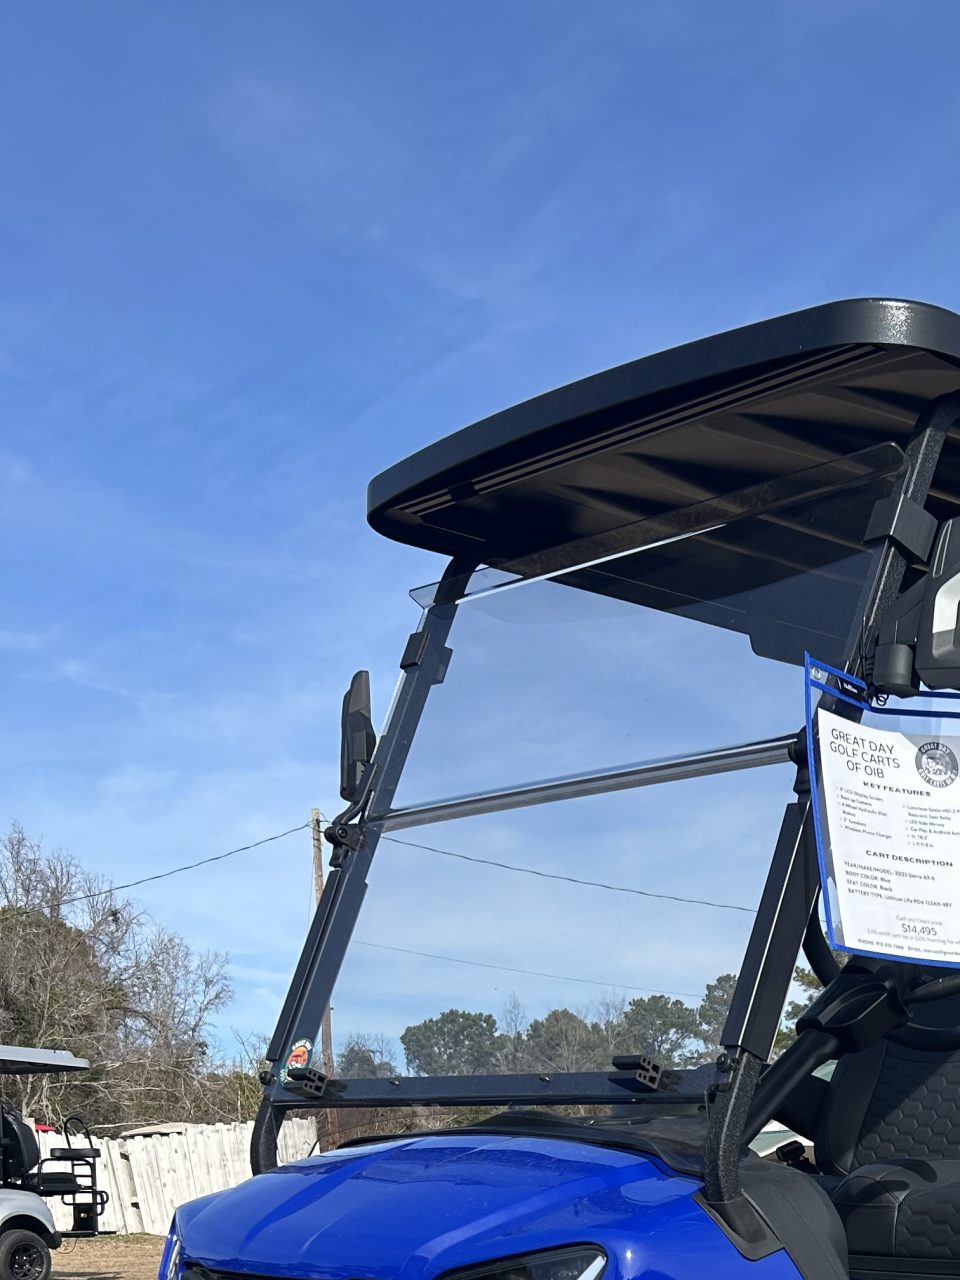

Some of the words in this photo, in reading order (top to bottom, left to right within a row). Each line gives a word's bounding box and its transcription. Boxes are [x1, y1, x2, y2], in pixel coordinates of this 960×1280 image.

[831, 728, 866, 749] GREAT
[869, 740, 894, 755] DAY
[829, 741, 858, 758] GOLF
[861, 751, 901, 769] CARTS
[846, 760, 861, 772] OF
[864, 765, 885, 779] OIB
[863, 780, 881, 790] KEY
[883, 785, 931, 797] FEATURES
[865, 850, 890, 860] CART
[891, 855, 953, 867] DESCRIPTION
[845, 869, 859, 877] BODY
[846, 878, 858, 886] SEAT
[848, 887, 869, 897] BATTERY
[901, 923, 938, 937] $14,495
